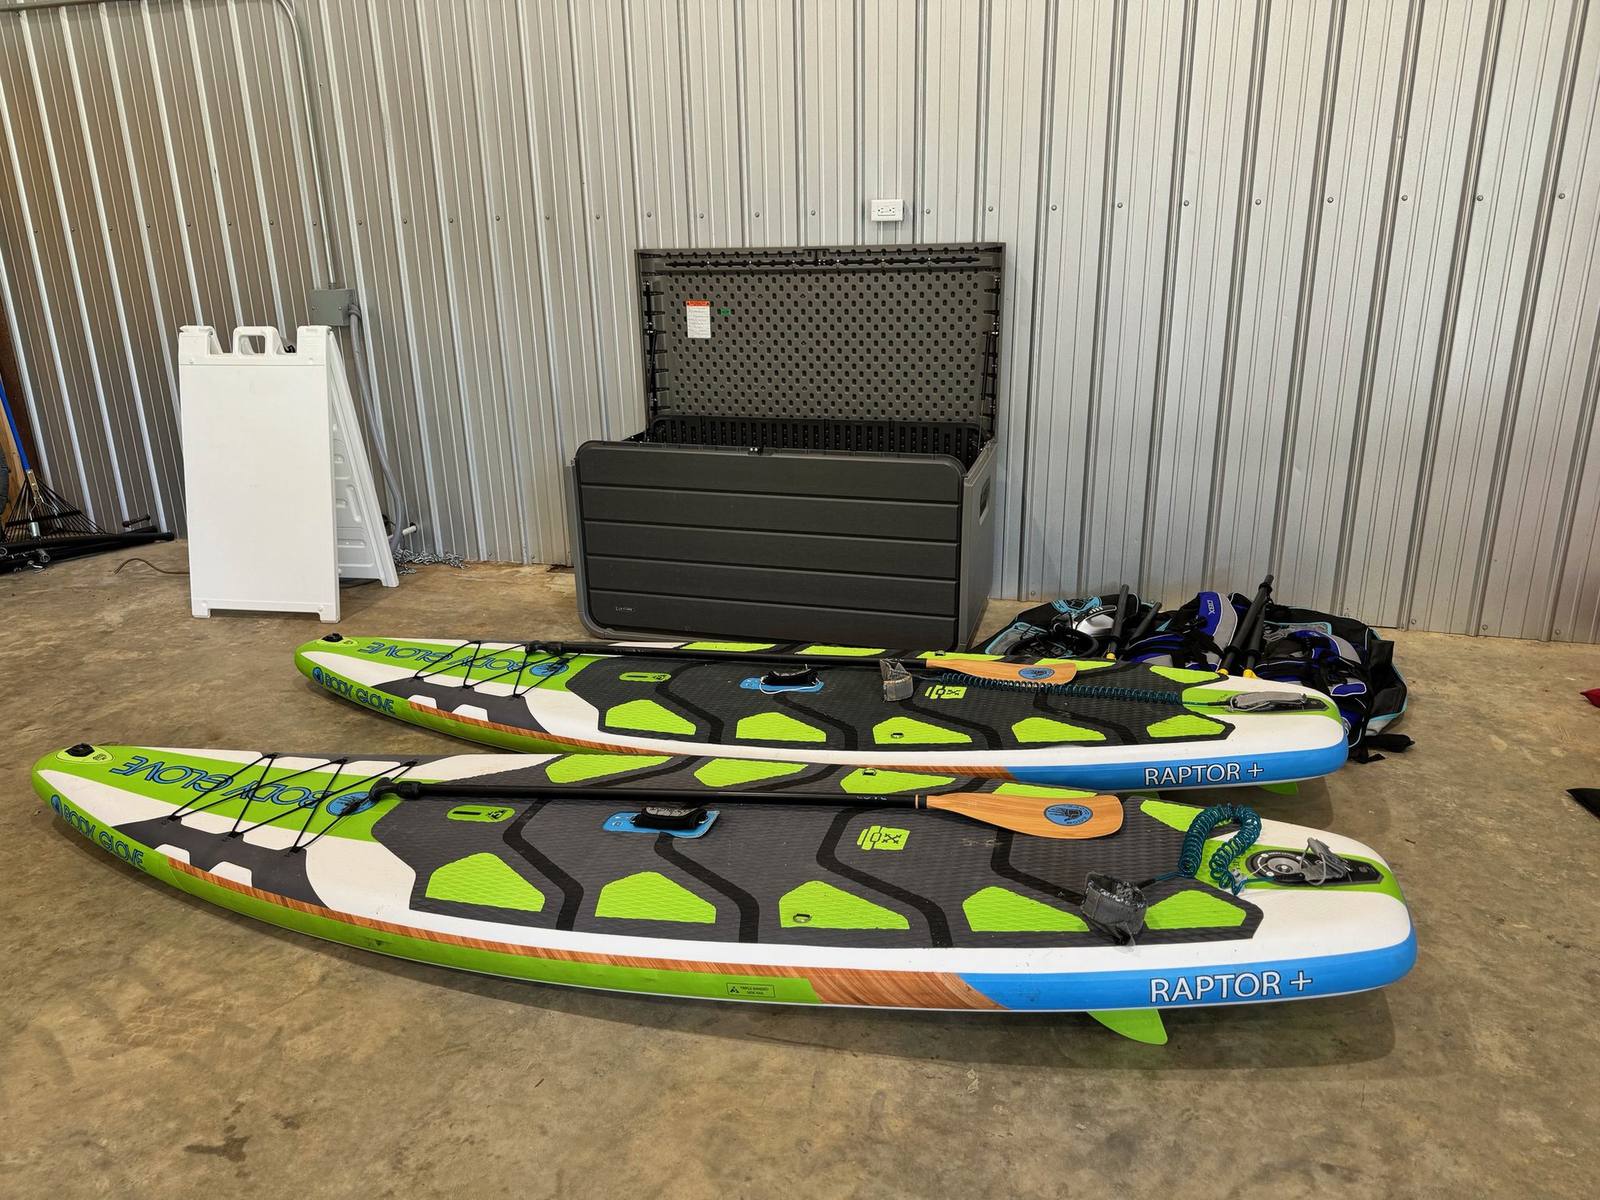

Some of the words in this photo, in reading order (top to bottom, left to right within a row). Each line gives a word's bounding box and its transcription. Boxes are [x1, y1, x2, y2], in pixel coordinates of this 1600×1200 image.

[357, 641, 454, 665] GLOVE
[448, 654, 530, 674] BODY
[325, 673, 354, 698] BODY
[356, 688, 395, 714] GLOVE
[109, 755, 234, 793] GLOVE
[1144, 763, 1241, 786] RAPTOR
[222, 780, 332, 810] BODY
[63, 803, 97, 841] BODY
[99, 831, 146, 871] GLOVE
[1150, 971, 1281, 1003] RAPTOR
